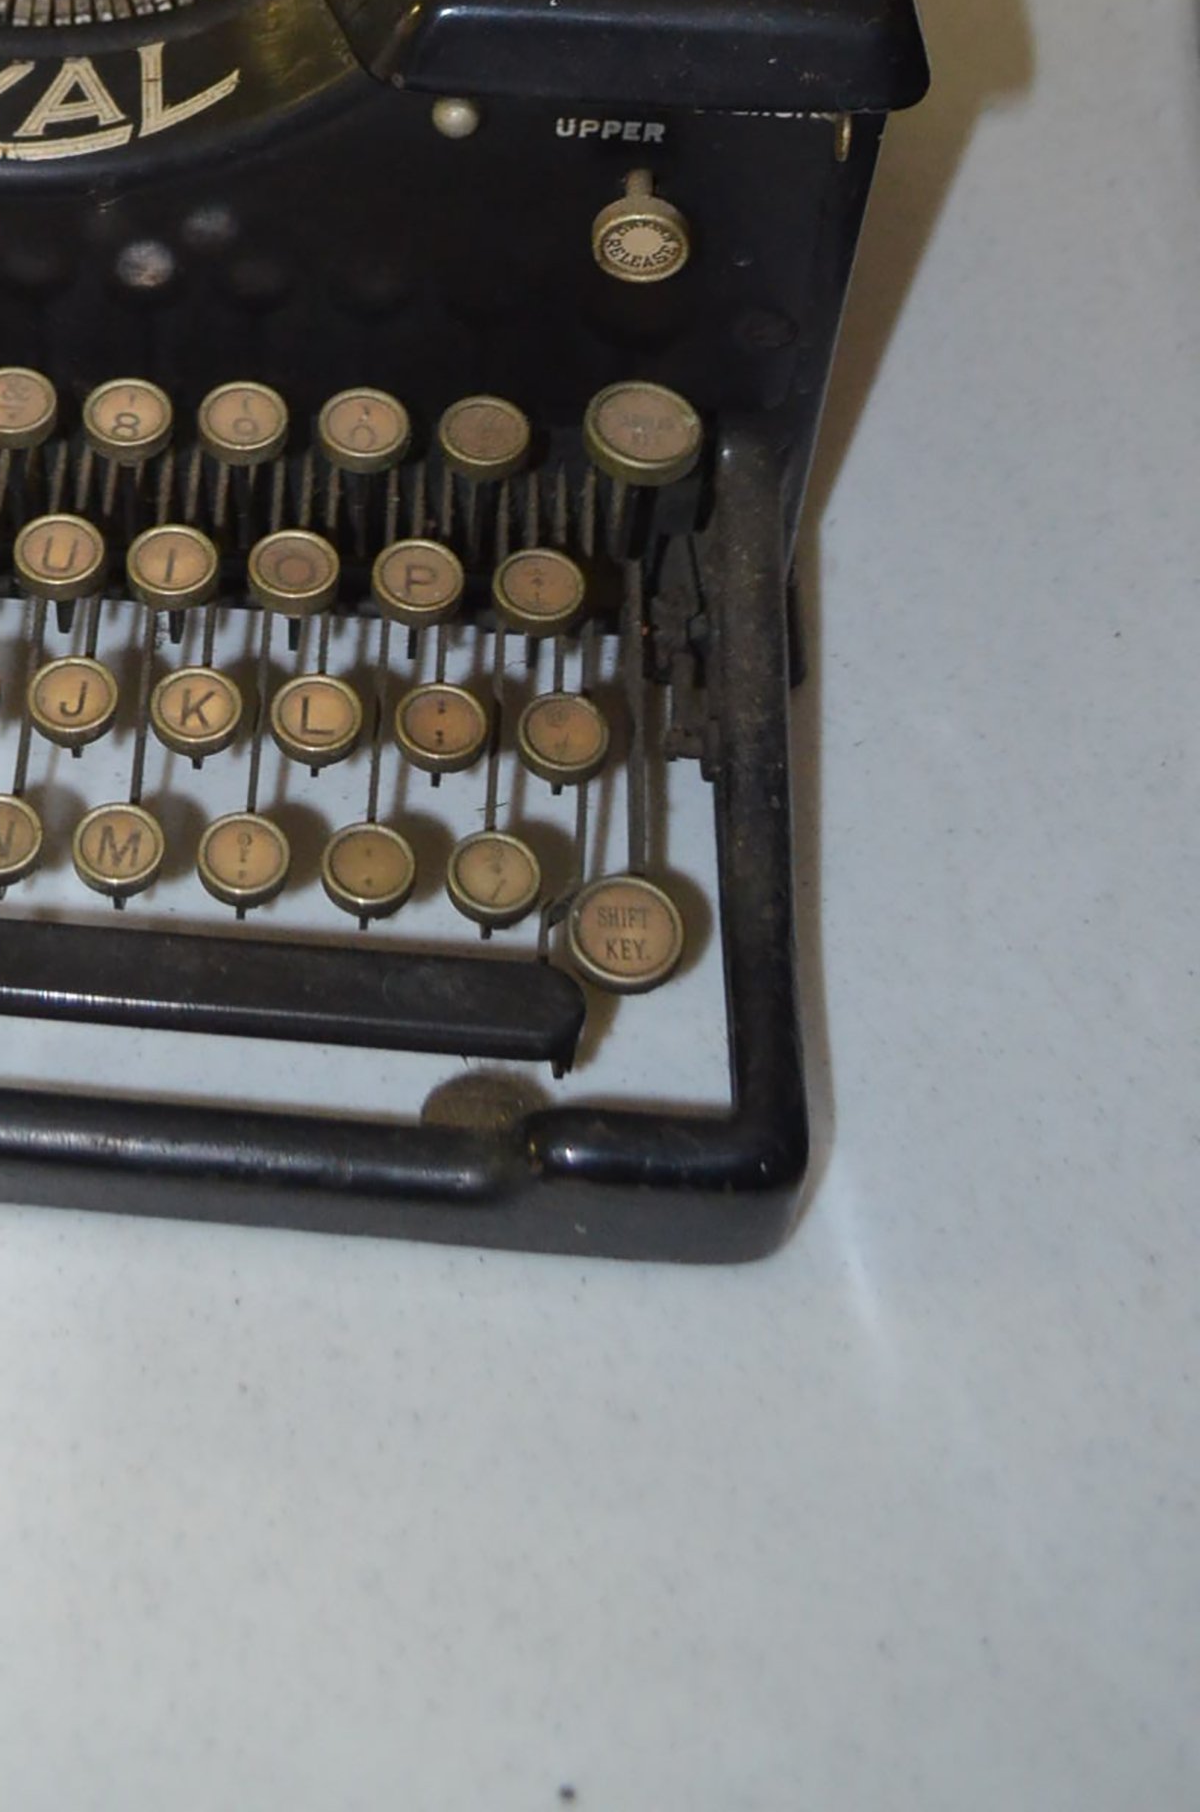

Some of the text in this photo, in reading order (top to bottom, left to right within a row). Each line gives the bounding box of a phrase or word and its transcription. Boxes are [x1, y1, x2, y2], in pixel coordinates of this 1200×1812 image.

[554, 116, 667, 145] UPPER
[605, 237, 678, 269] RELEASE
[112, 411, 141, 437] 8
[41, 535, 79, 573] U
[163, 547, 177, 584] I
[273, 551, 319, 586] O
[403, 562, 439, 601] P
[58, 680, 90, 718] J
[179, 687, 218, 730] K
[300, 694, 337, 736] L
[96, 824, 143, 868] M
[597, 906, 650, 930] SHIFT
[605, 938, 652, 962] KEY.
